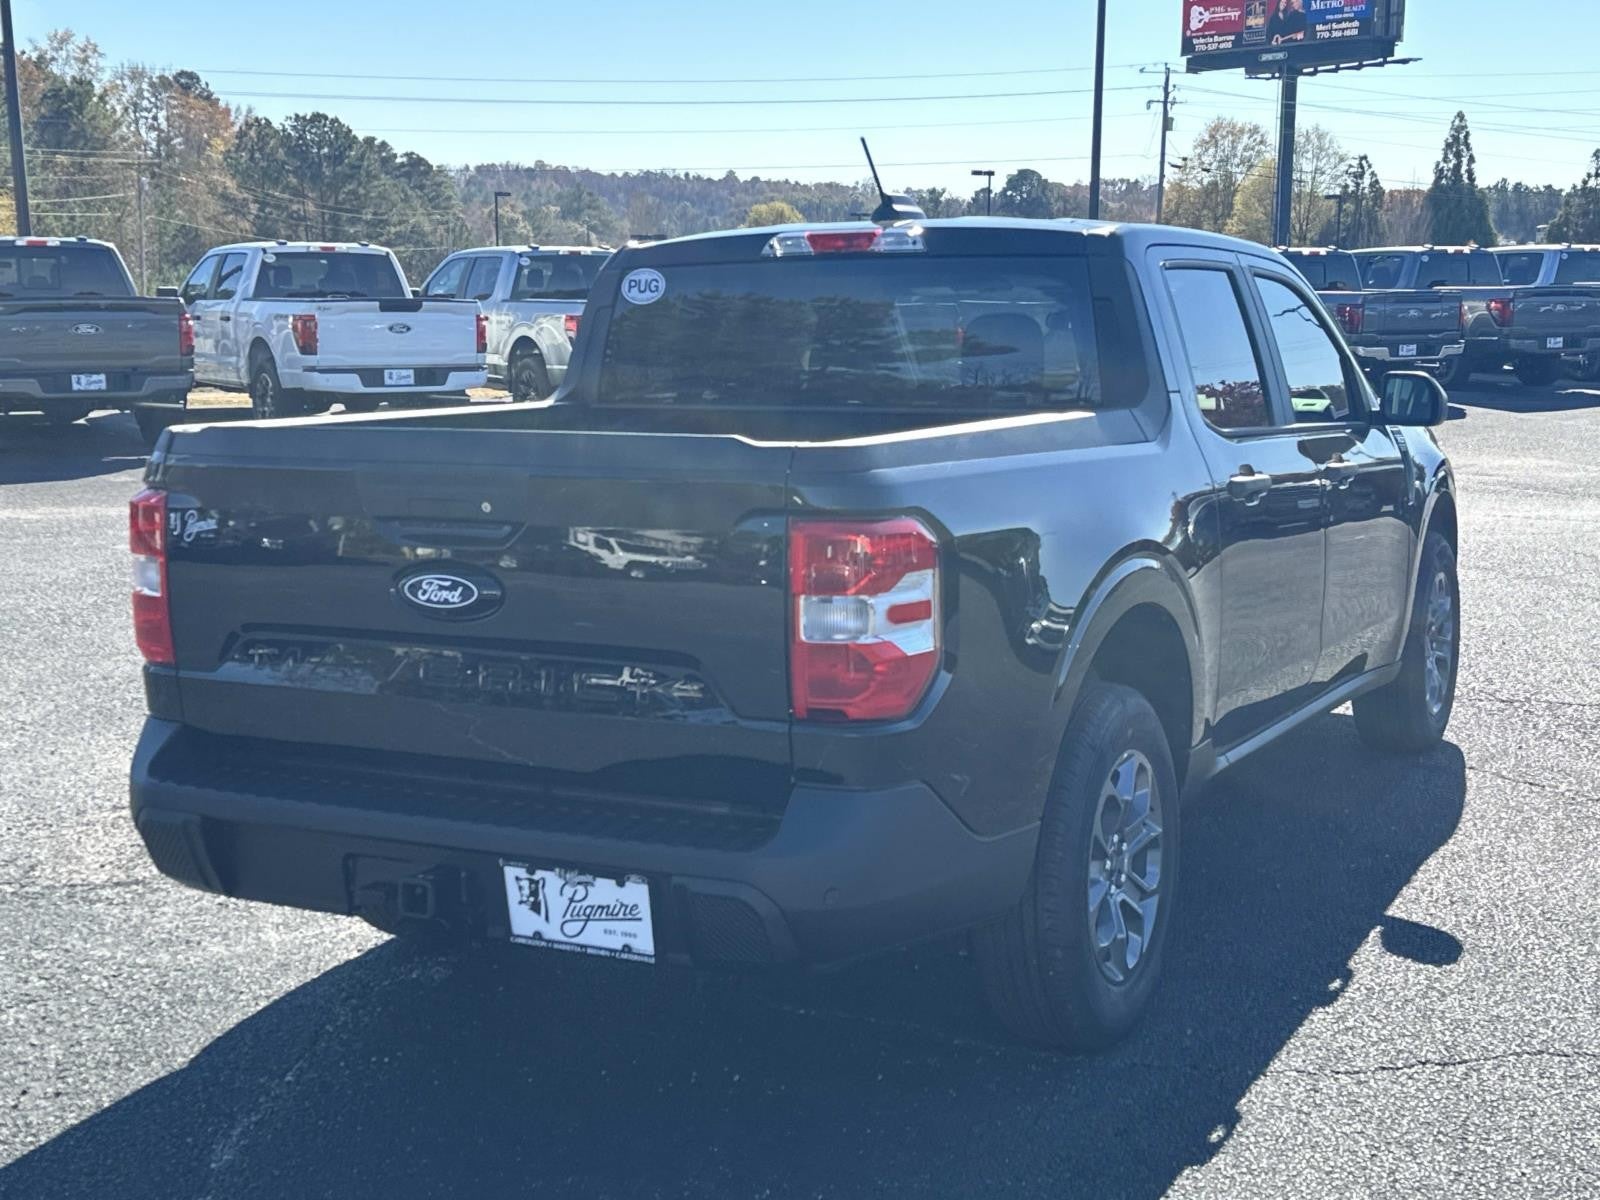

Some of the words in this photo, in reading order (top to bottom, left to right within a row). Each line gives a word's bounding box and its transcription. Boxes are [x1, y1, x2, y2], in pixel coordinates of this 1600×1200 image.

[627, 278, 660, 294] PUG
[417, 579, 463, 603] Ford
[559, 881, 642, 938] Pugmire
